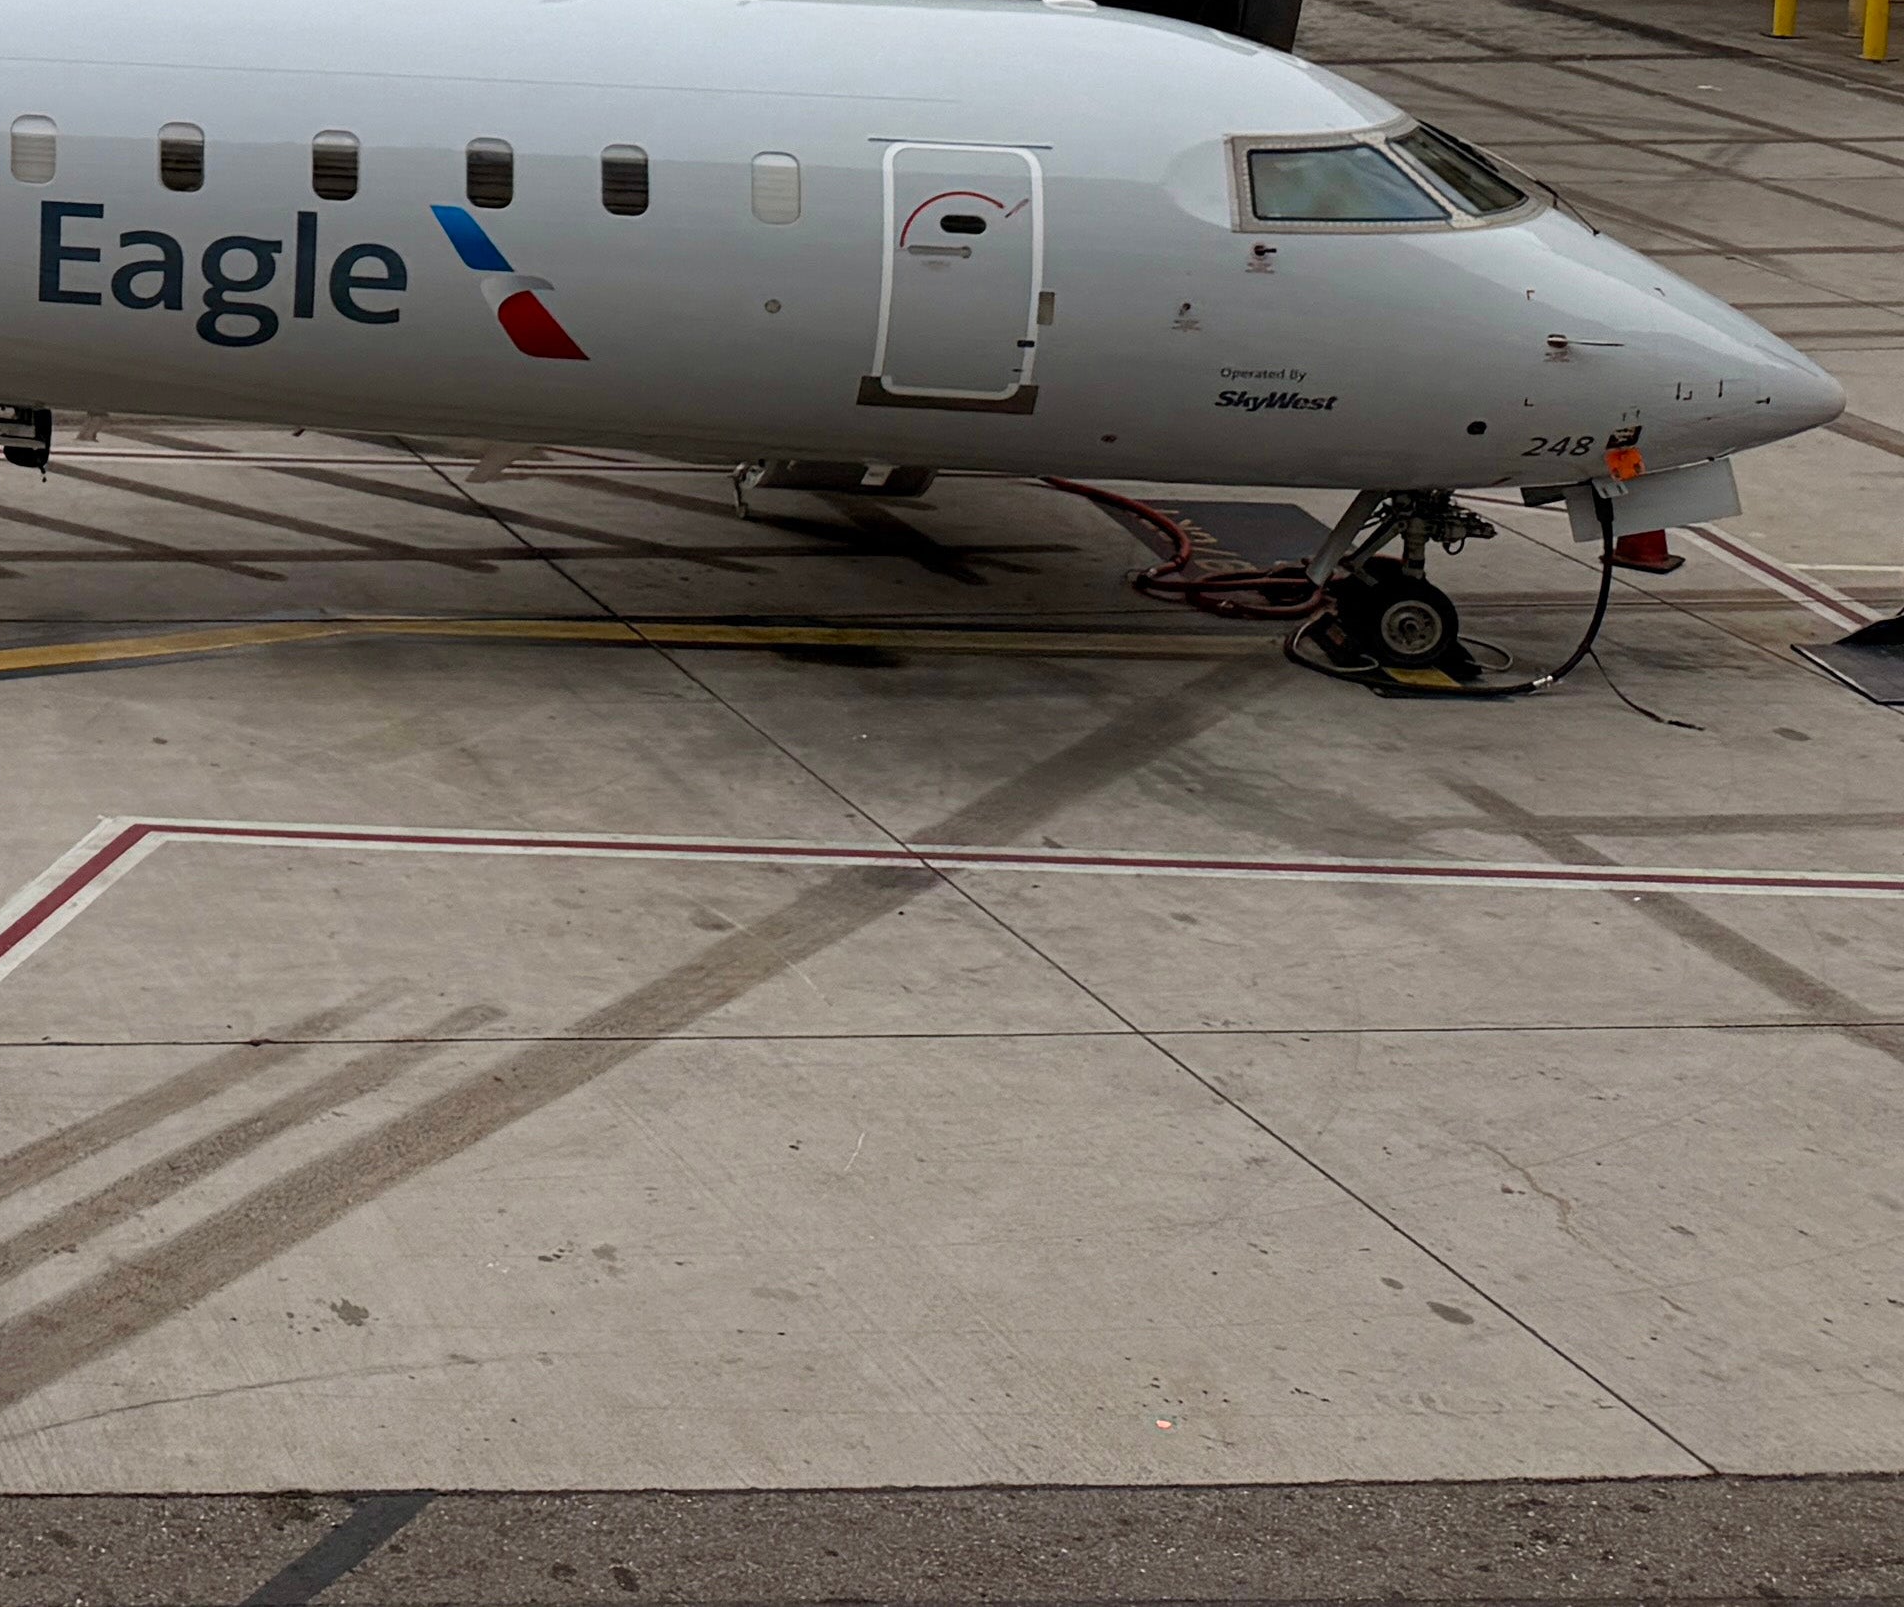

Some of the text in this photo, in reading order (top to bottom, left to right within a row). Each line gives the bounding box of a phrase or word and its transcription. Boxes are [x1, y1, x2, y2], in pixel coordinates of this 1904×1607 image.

[38, 200, 408, 348] Eagle
[1220, 367, 1286, 380] Operated
[1214, 390, 1338, 412] SkyWest
[1521, 436, 1594, 456] 248
